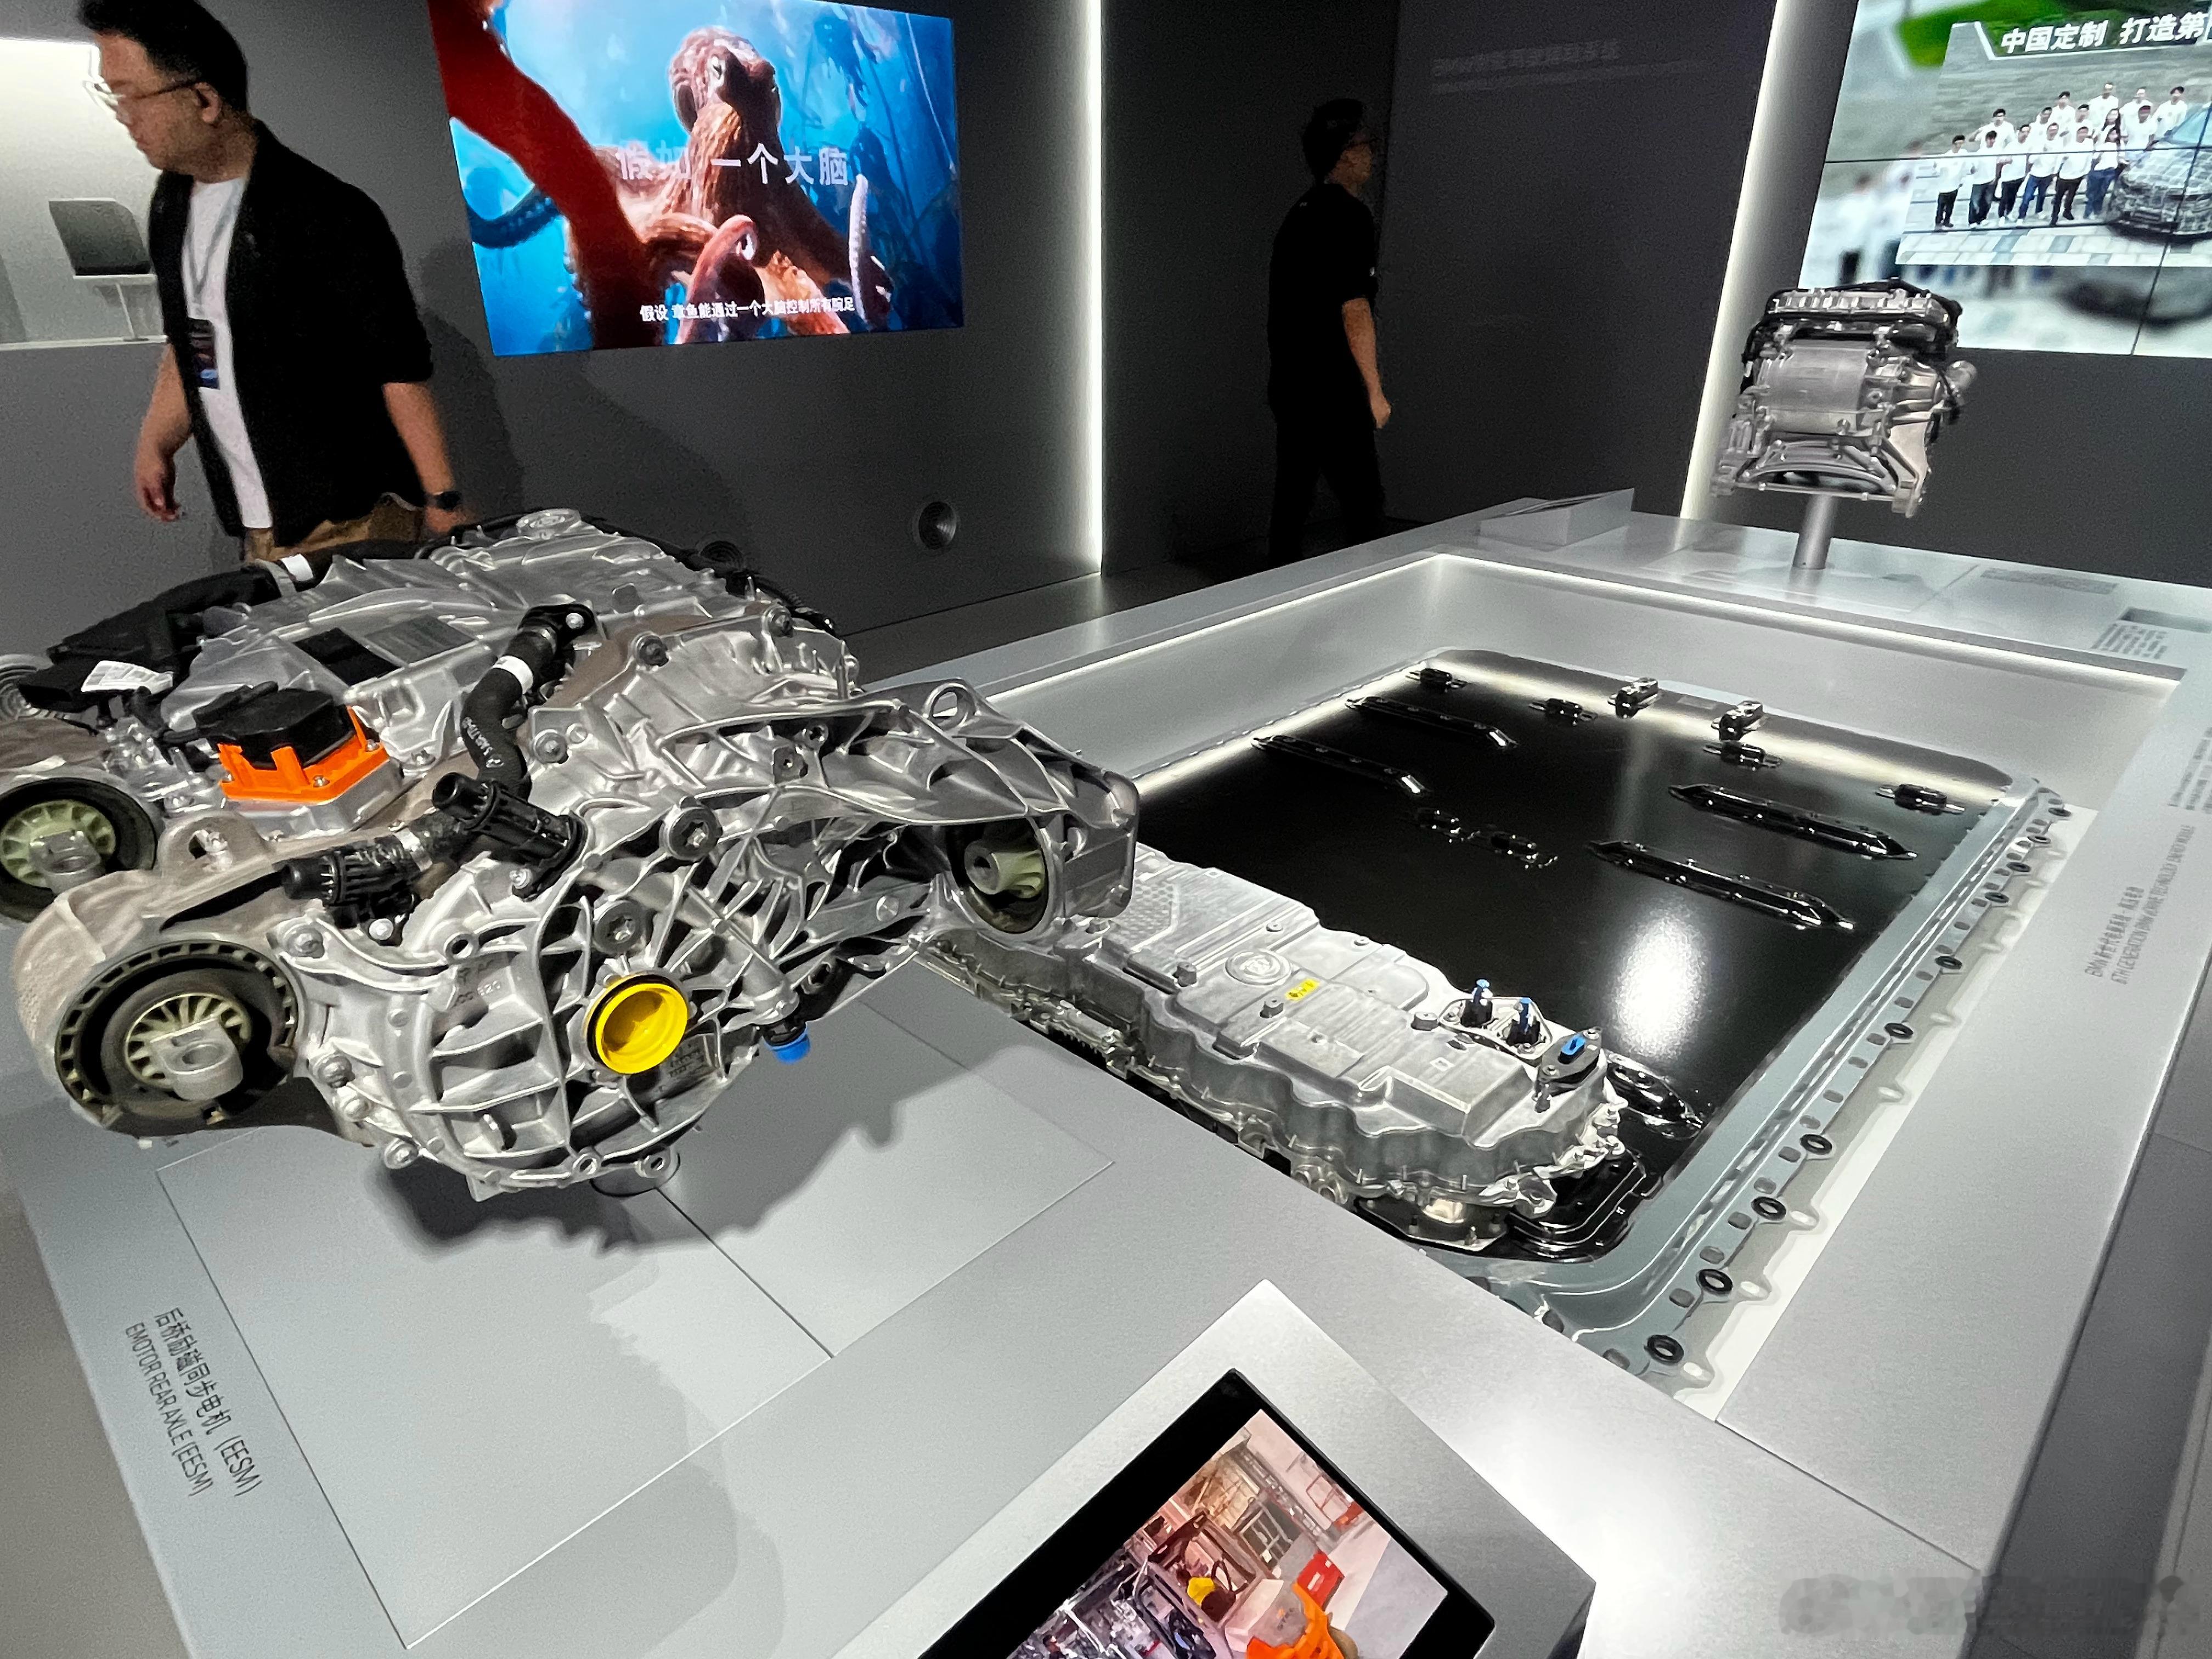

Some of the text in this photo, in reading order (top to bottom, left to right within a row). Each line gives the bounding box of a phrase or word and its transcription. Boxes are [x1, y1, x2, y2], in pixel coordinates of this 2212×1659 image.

[2001, 11, 2209, 54] 中国定制 打造第
[710, 143, 848, 185] 一个大脑
[640, 304, 669, 321] 假设
[154, 1307, 231, 1435] 后桥励磁同步电机
[125, 1322, 213, 1497] EMOTOR REAR AXLE (EESM)
